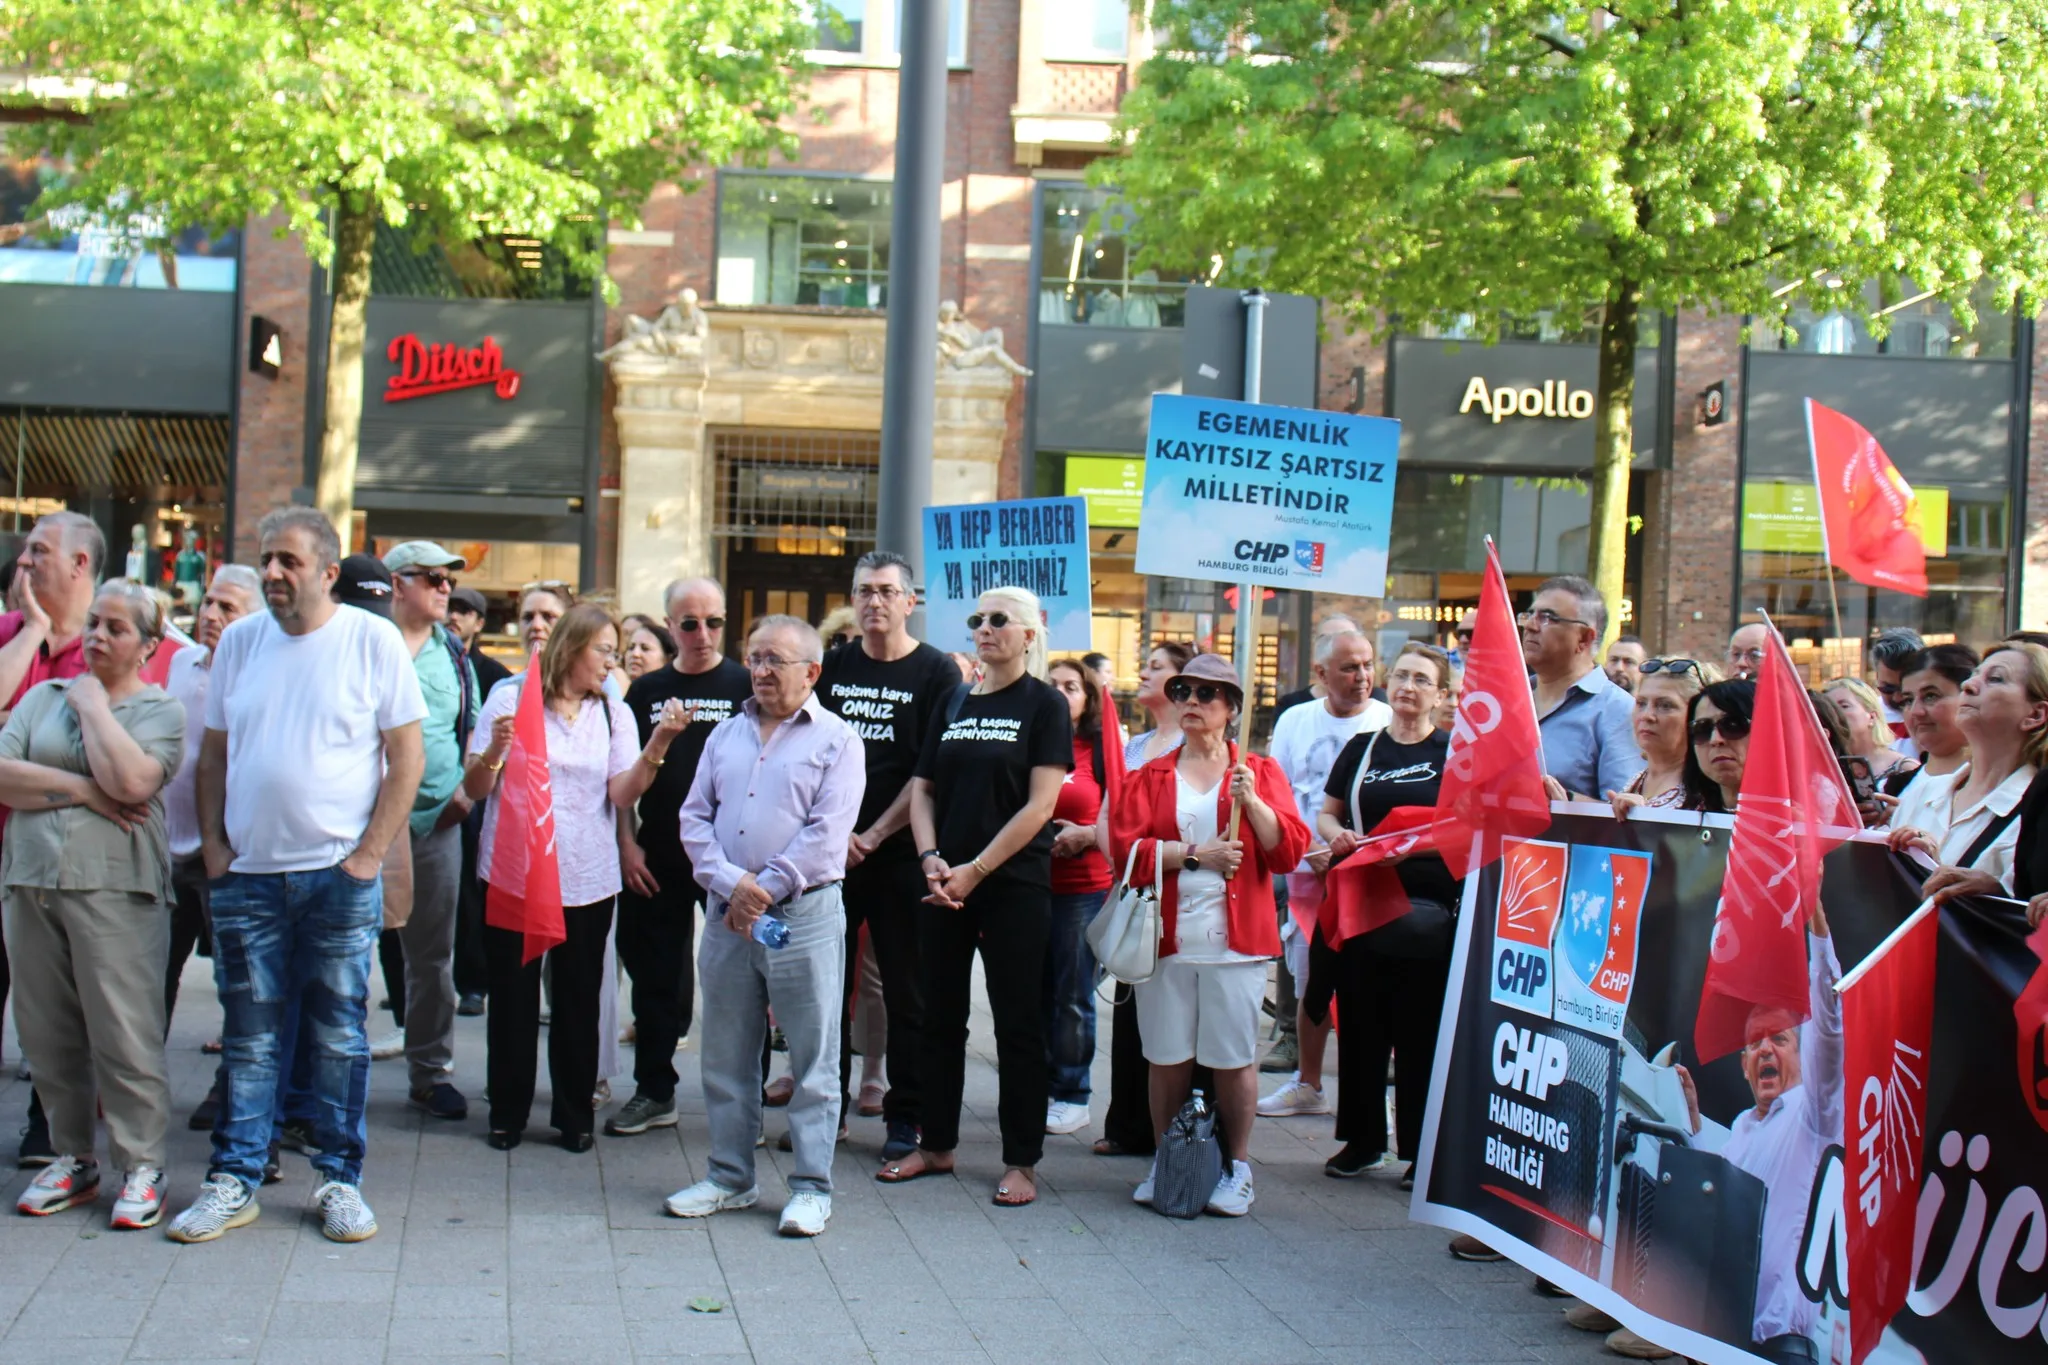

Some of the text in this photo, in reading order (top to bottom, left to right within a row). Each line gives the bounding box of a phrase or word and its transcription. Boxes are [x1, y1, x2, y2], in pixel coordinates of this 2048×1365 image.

[386, 332, 504, 388] Ditsch
[1459, 376, 1594, 424] Apollo
[1198, 410, 1350, 447] EGEMENLİK
[1155, 438, 1386, 484] KAYITSIZ ŞARTSIZ
[1183, 473, 1350, 515] MİLLETİNDİR
[934, 504, 1076, 550] YA HEP BERABER
[1274, 513, 1373, 532] Mustafa Kemal Atatürk
[1197, 559, 1250, 573] HAMBURG
[1252, 564, 1289, 577] BİRLİĞİ
[1233, 539, 1290, 564] CHP
[944, 561, 964, 599] YA
[831, 683, 914, 704] Faşizme karşı
[841, 699, 895, 720] OMUZ
[846, 719, 895, 742] MUZA
[980, 717, 1022, 730] BAŞKAN
[1497, 948, 1548, 998] CHP
[1600, 969, 1630, 992] CHP
[1556, 993, 1624, 1031] Hamburg Birliği
[1492, 1021, 1568, 1101] CHP
[1488, 1092, 1570, 1153] HAMBURG
[1485, 1133, 1544, 1190] BİRLİĞİ
[1858, 1075, 1884, 1228] CHP
